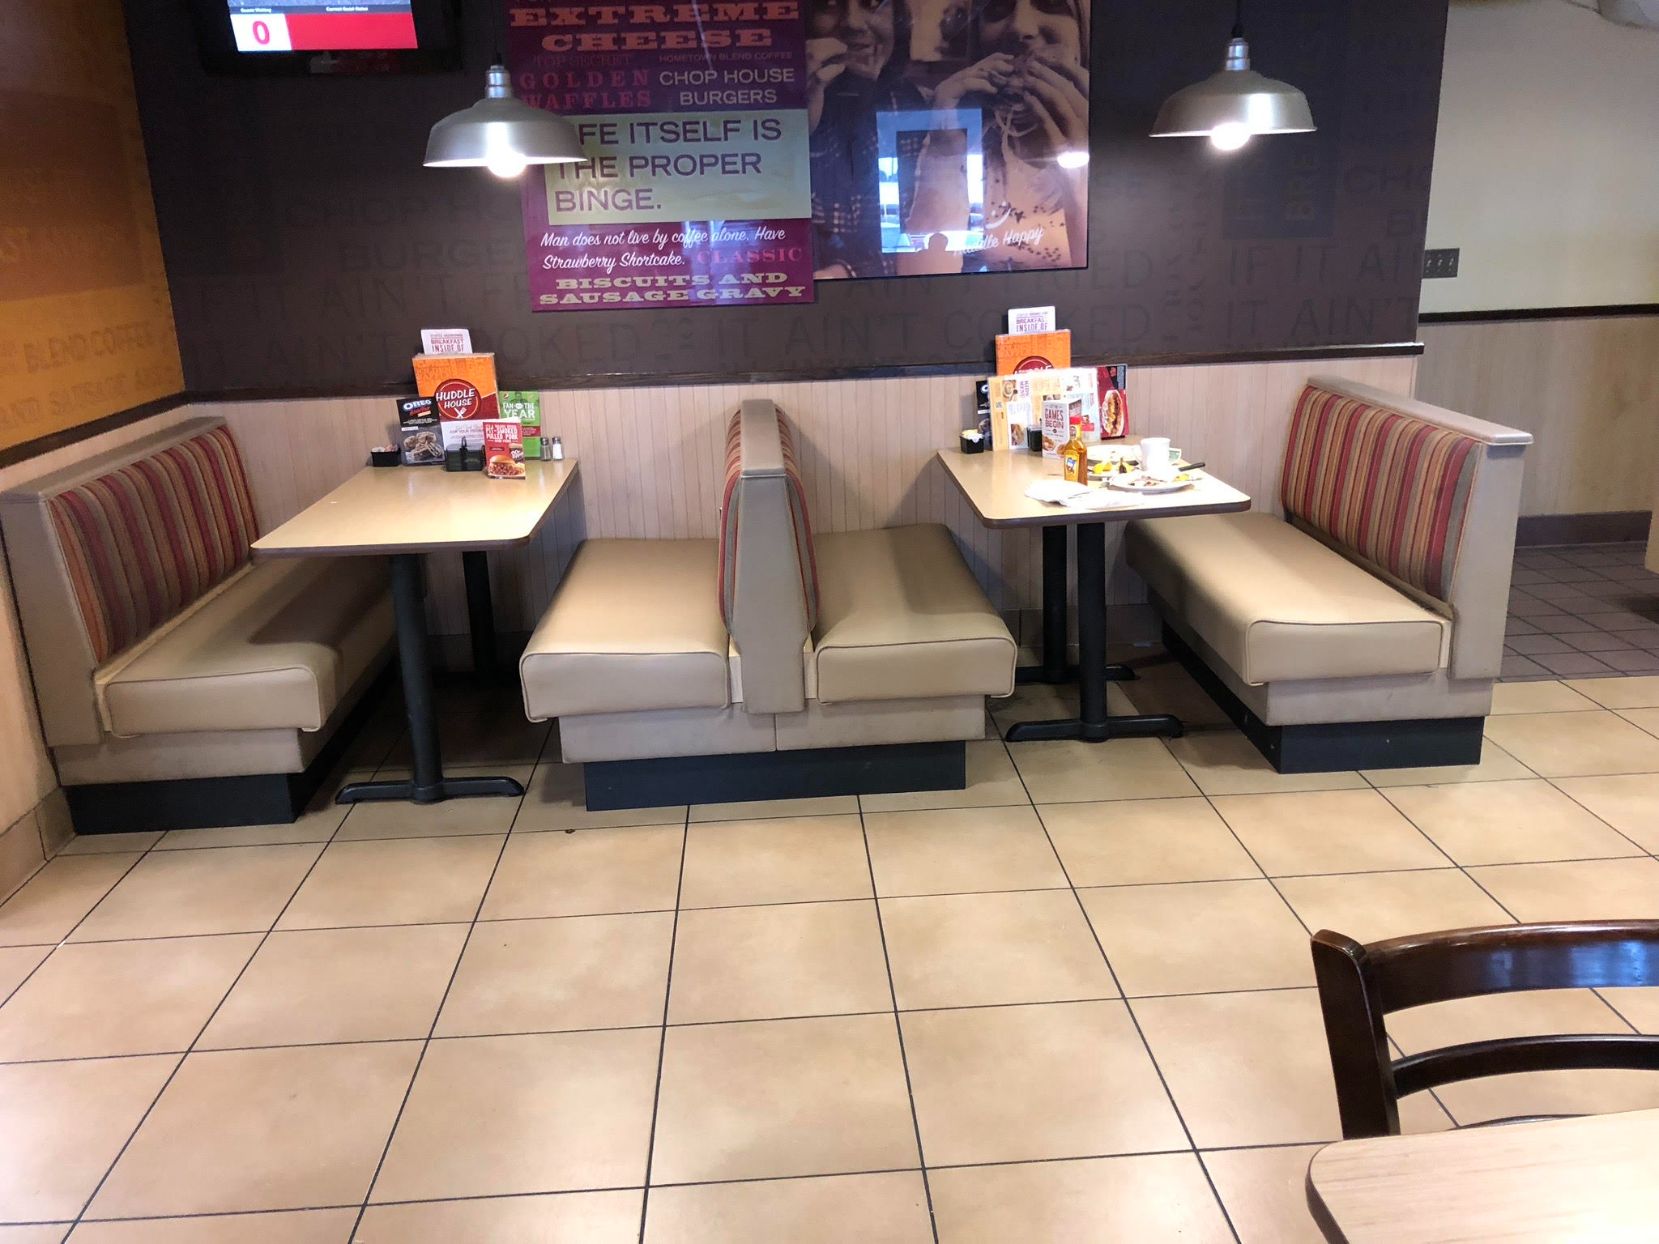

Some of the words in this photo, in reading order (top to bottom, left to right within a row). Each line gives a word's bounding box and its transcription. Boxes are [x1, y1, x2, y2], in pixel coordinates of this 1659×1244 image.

[510, 1, 799, 26] EXTREME
[252, 20, 271, 45] 0
[542, 28, 772, 51] CHEESE
[520, 69, 649, 89] GOLDEN
[659, 70, 718, 86] CHOP
[723, 68, 795, 84] HOUSE
[680, 89, 777, 105] BURGERS
[578, 122, 619, 146] FE
[629, 119, 741, 144] ITSELF
[753, 118, 782, 141] IS
[629, 152, 762, 178] PROPER
[555, 188, 661, 212] BINGE.
[541, 232, 569, 246] Man
[572, 231, 600, 245] does
[603, 231, 625, 245] not
[627, 229, 649, 244] live
[652, 228, 668, 251] by
[671, 226, 708, 249] coffee
[711, 227, 750, 242] alone.
[753, 226, 786, 240] Have
[1003, 228, 1044, 247] Happy
[542, 253, 617, 274] Strawberry
[619, 250, 686, 267] Shortcake.
[696, 246, 801, 264] CLASSIC
[556, 274, 710, 290] BISCUITS
[718, 272, 788, 286] AND
[539, 290, 689, 305] SAUSAGE
[696, 286, 806, 301] GRAVY
[436, 388, 475, 402] HUDDLE
[444, 398, 472, 409] HOUSE
[403, 400, 432, 411] OREO
[503, 409, 536, 419] YEAR
[1044, 408, 1064, 421] GAMES
[1045, 420, 1065, 430] BEGIN
